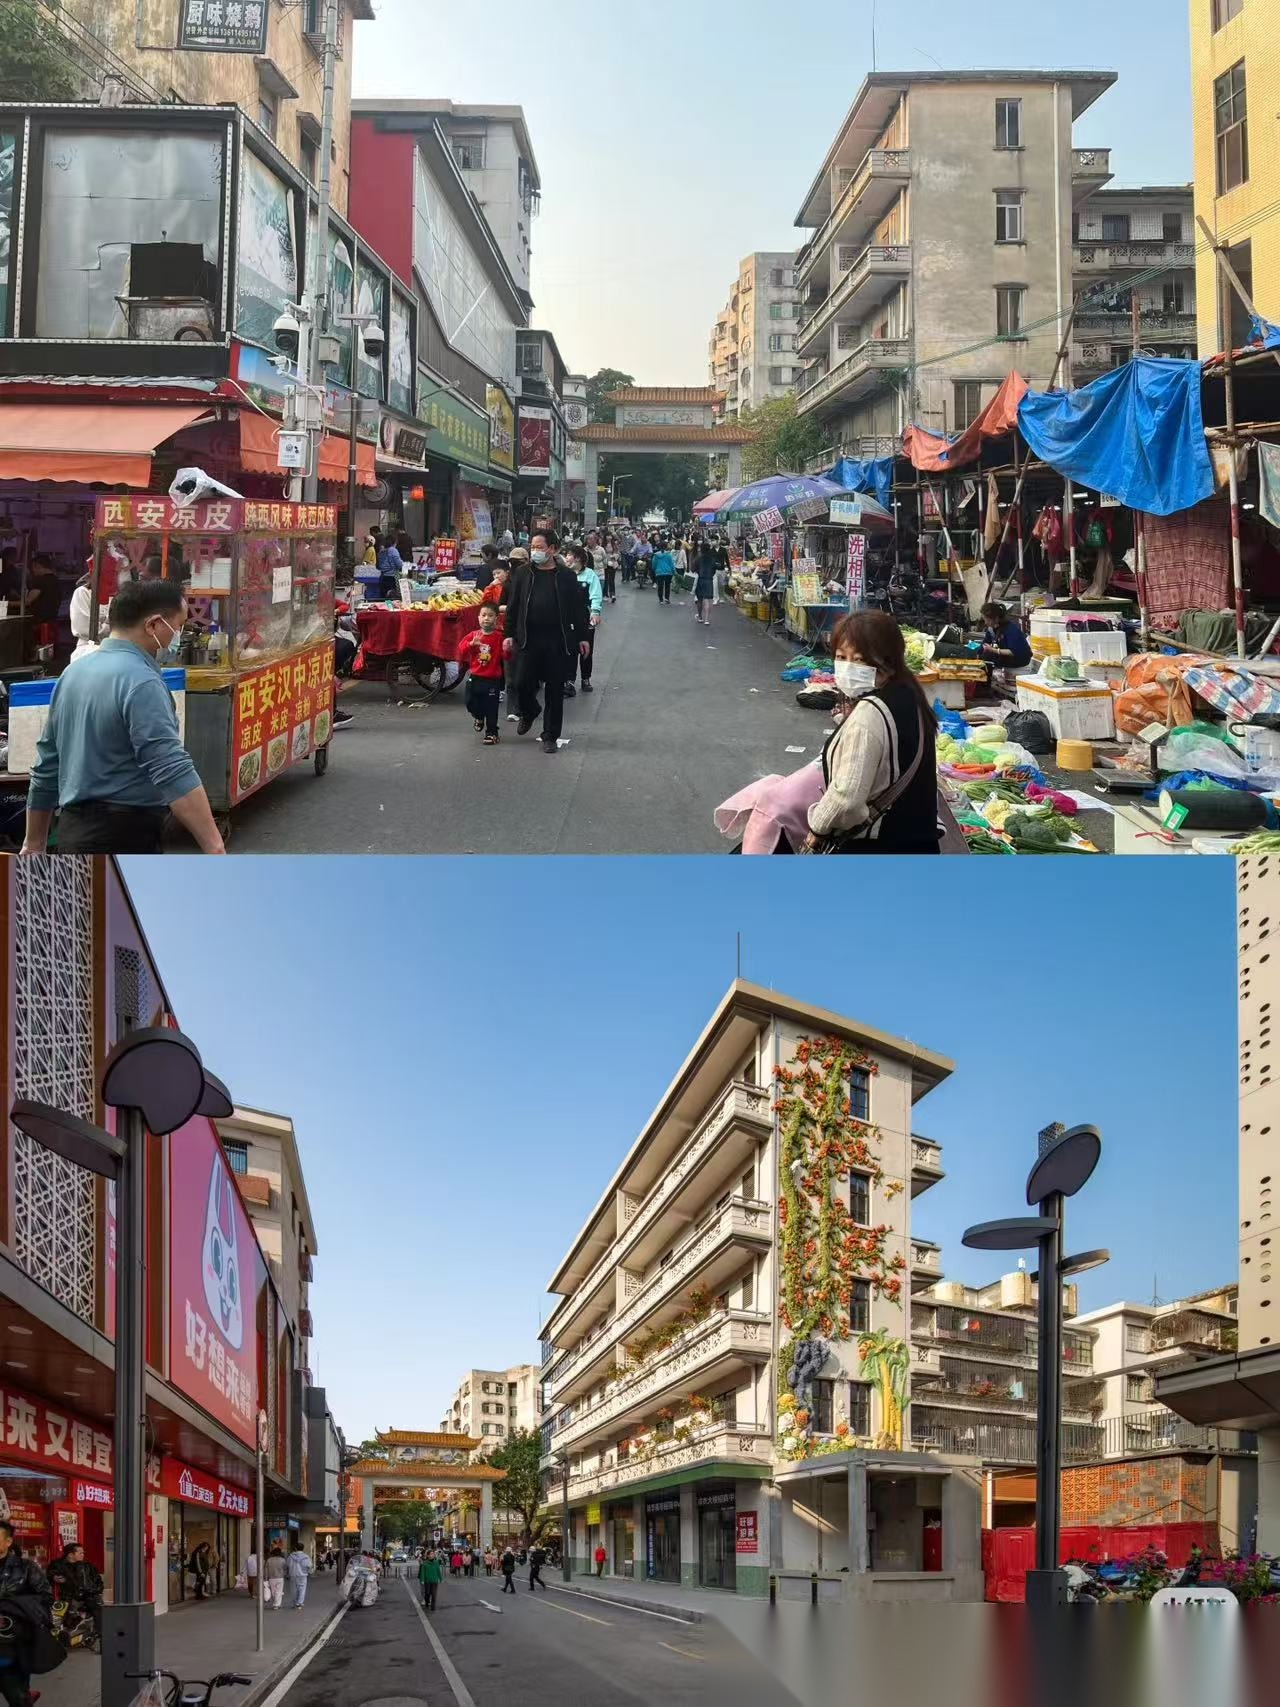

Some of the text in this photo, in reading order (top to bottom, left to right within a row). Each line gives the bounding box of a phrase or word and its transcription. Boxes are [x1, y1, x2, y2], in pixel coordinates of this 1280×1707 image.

[104, 499, 232, 530] 西安凉皮
[244, 501, 337, 529] 陕西风味 陕西风味
[847, 534, 865, 596] 洗相片
[237, 646, 335, 722] 西安汉中凉皮
[240, 719, 263, 750] 凉皮
[269, 706, 290, 735] 米皮
[185, 1297, 241, 1411] 好想来
[0, 1391, 112, 1474] 来又便宜
[218, 1483, 249, 1514] 2元大世界
